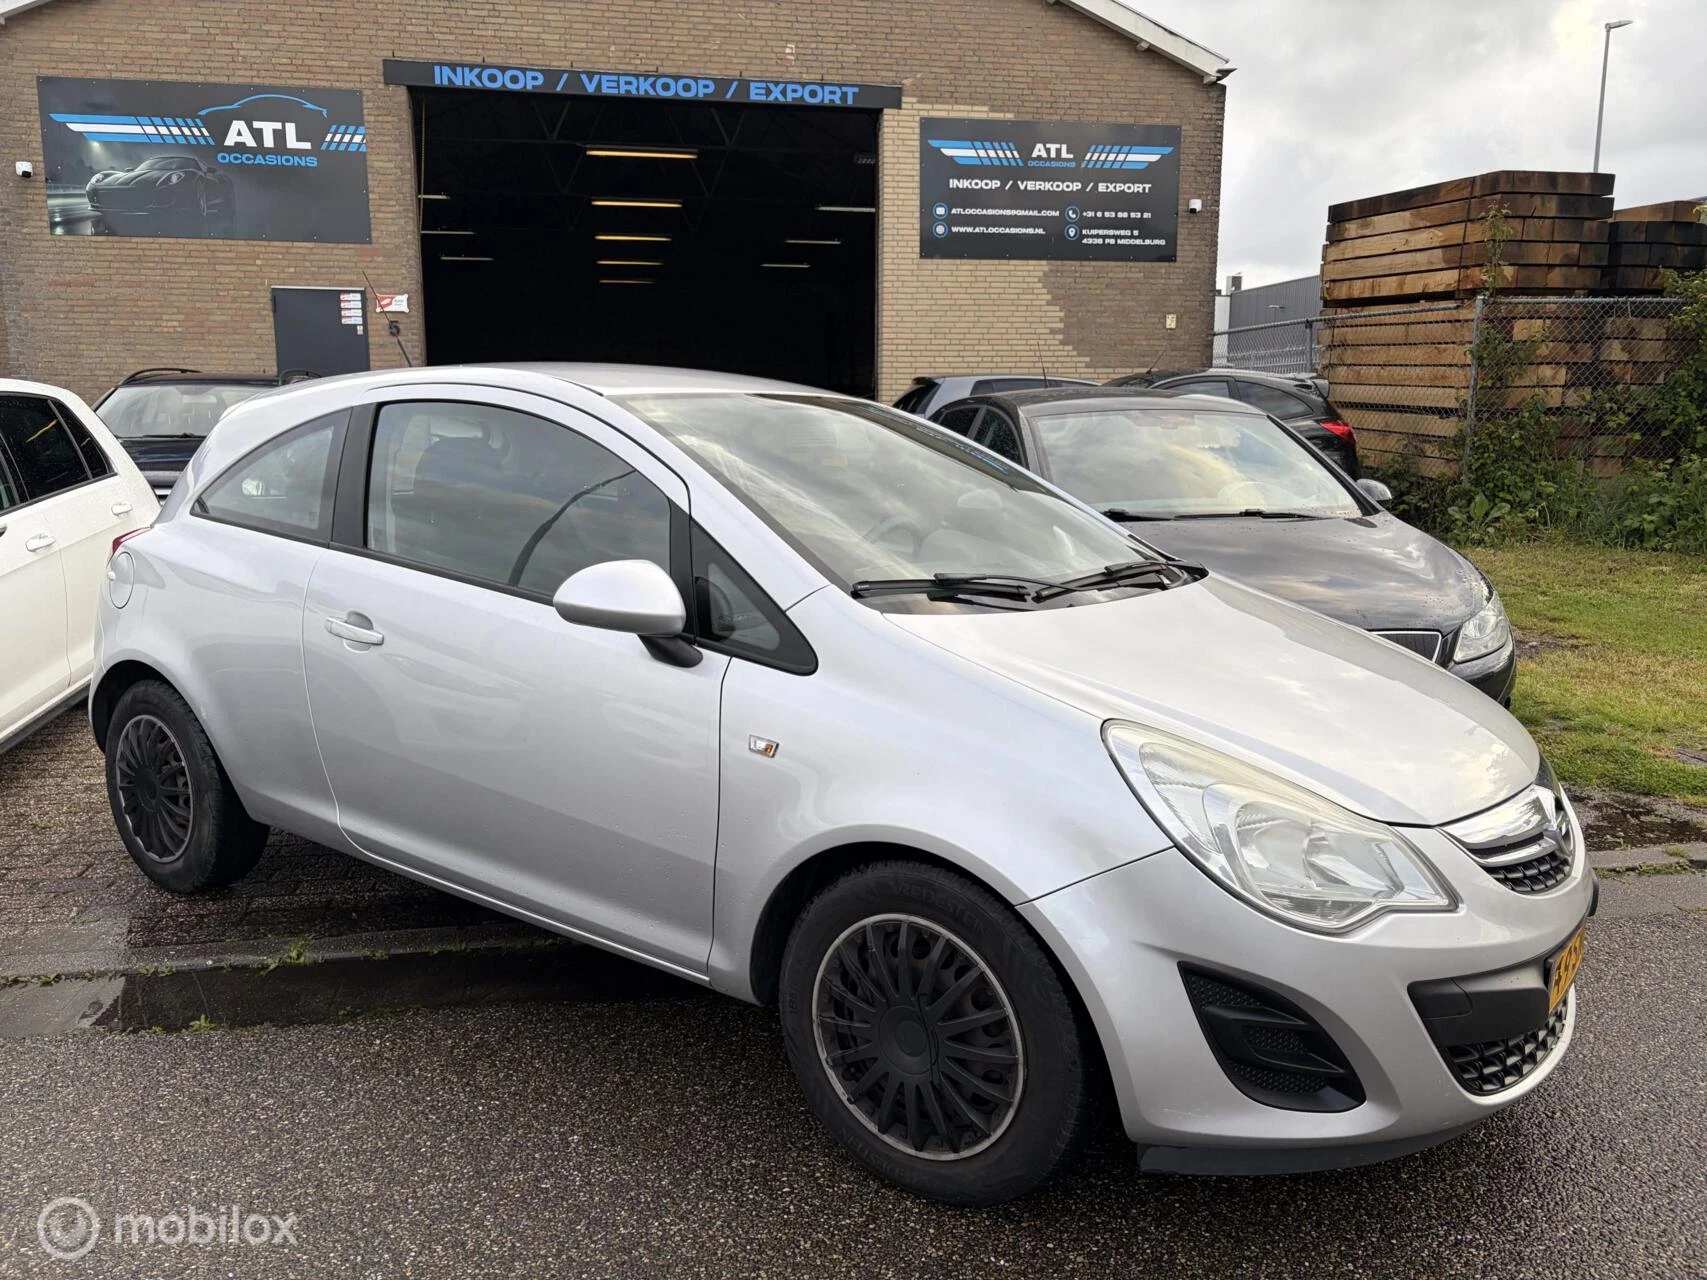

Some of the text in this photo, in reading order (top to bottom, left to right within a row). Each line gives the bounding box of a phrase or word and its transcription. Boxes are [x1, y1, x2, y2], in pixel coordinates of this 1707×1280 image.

[432, 65, 860, 105] INKOOP / VERKOOP / EXPORT
[223, 119, 313, 150] ATL
[1031, 143, 1074, 159] ATL
[216, 152, 318, 168] OCCASIONS
[1027, 160, 1076, 169] OCCASIONS
[949, 178, 1001, 190] INKOOP
[1017, 180, 1082, 192] VERKOOP
[1097, 182, 1152, 193] EXPORT
[389, 320, 400, 336] 5
